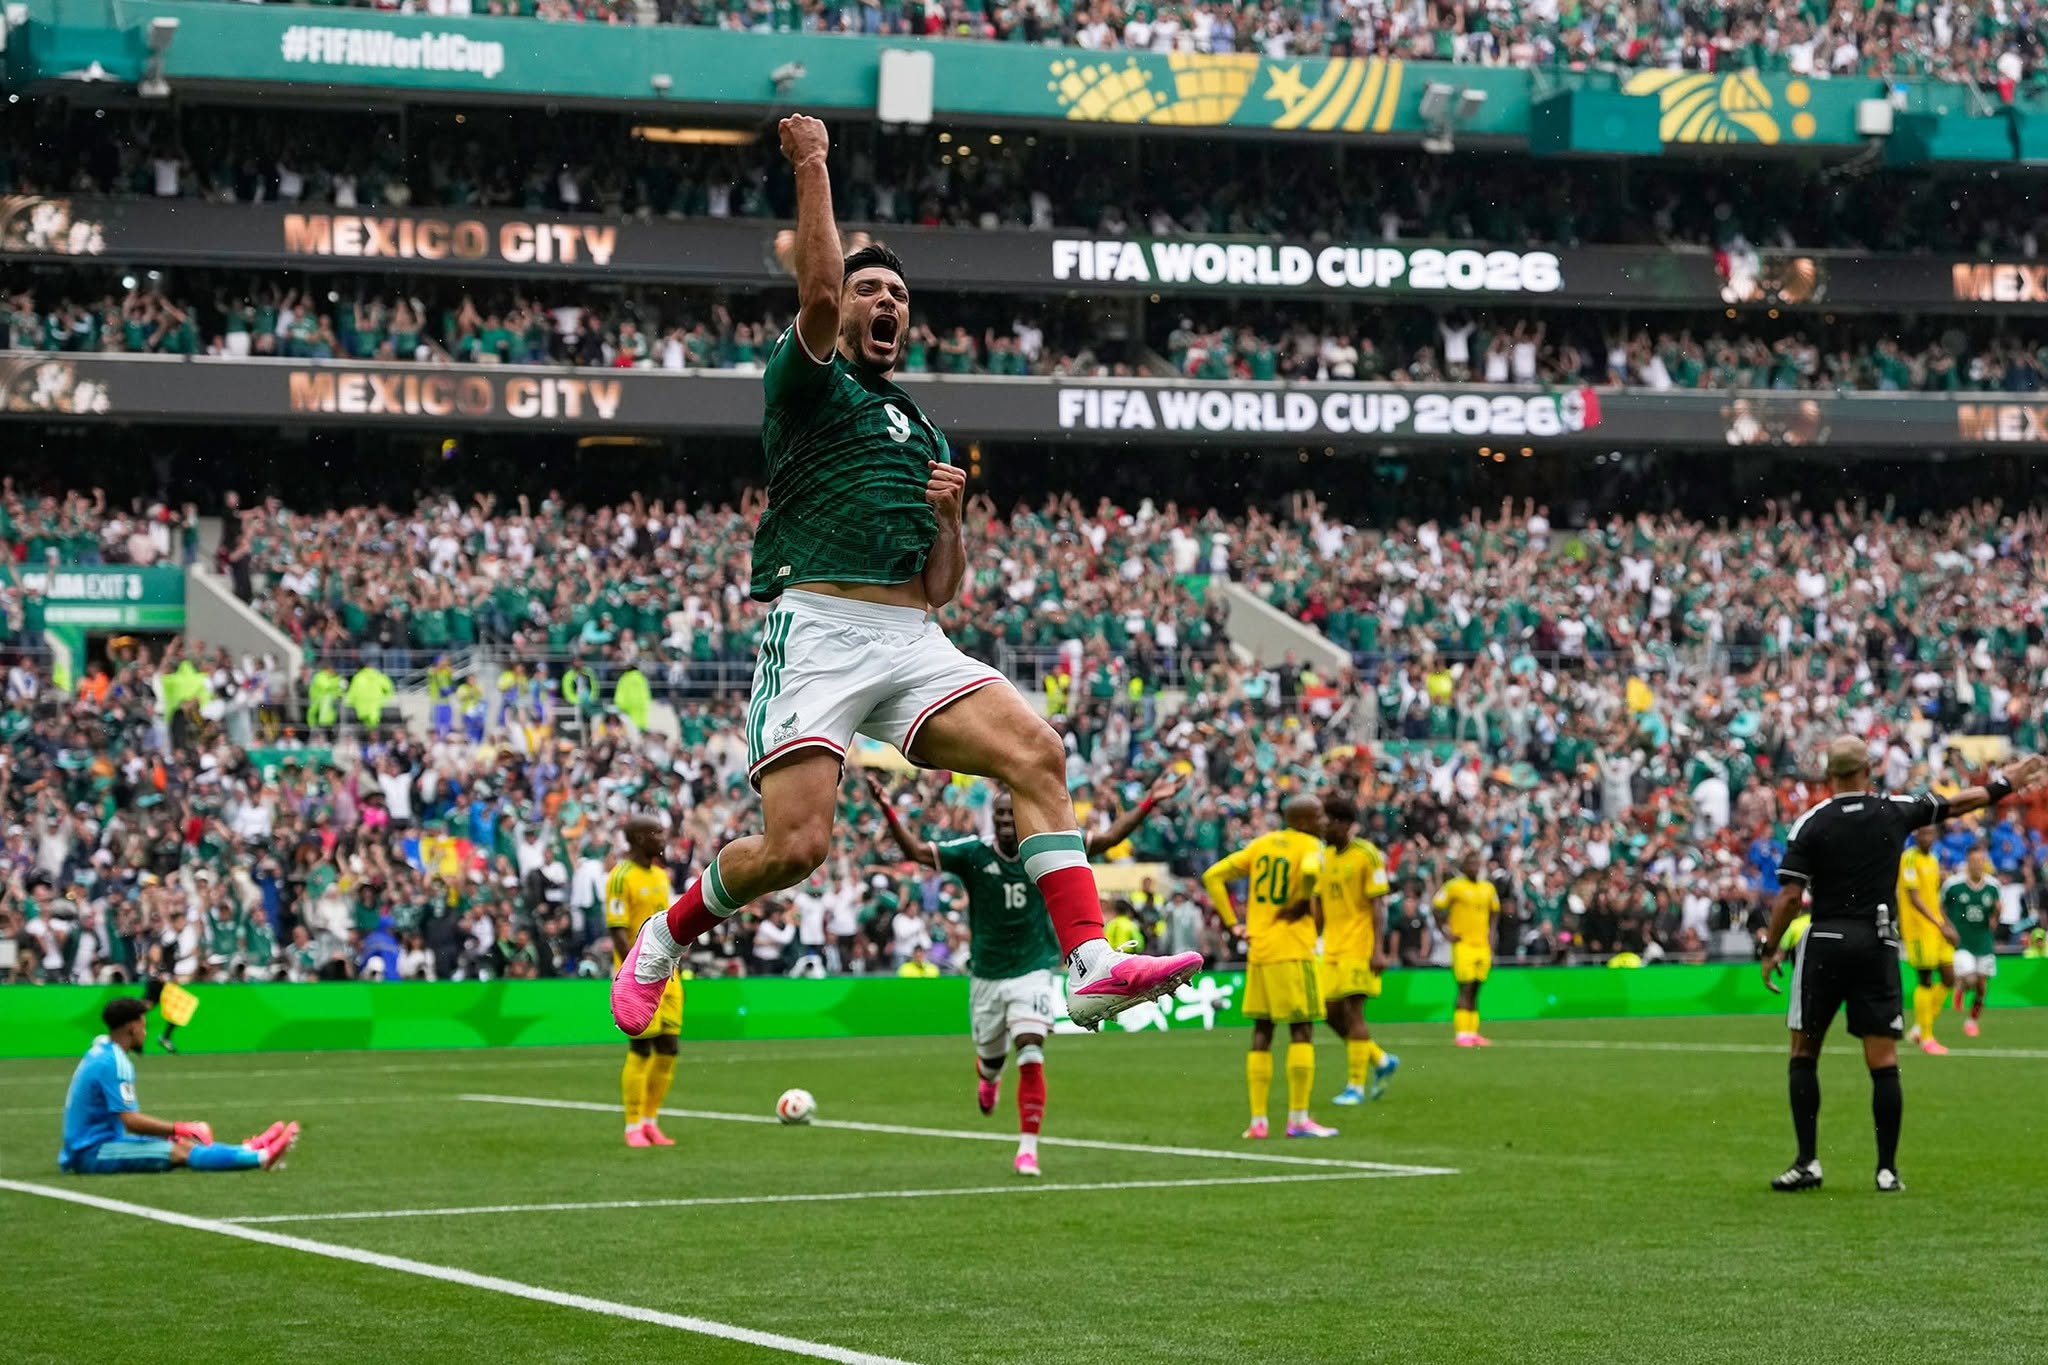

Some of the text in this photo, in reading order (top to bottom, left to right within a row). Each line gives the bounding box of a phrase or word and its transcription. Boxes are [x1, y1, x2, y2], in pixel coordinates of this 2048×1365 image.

[281, 25, 504, 79] #FIFAWorldCup
[284, 213, 617, 266] MEXICO CITY
[1052, 240, 1561, 293] FIFA WORLD CUP 2026
[289, 371, 622, 420] MEXICO CITY
[1058, 389, 1562, 436] FIFA WORLD CUP 2026
[884, 403, 911, 443] 9
[1002, 882, 1027, 910] 16
[1255, 855, 1290, 905] 20
[1033, 994, 1050, 1016] 16
